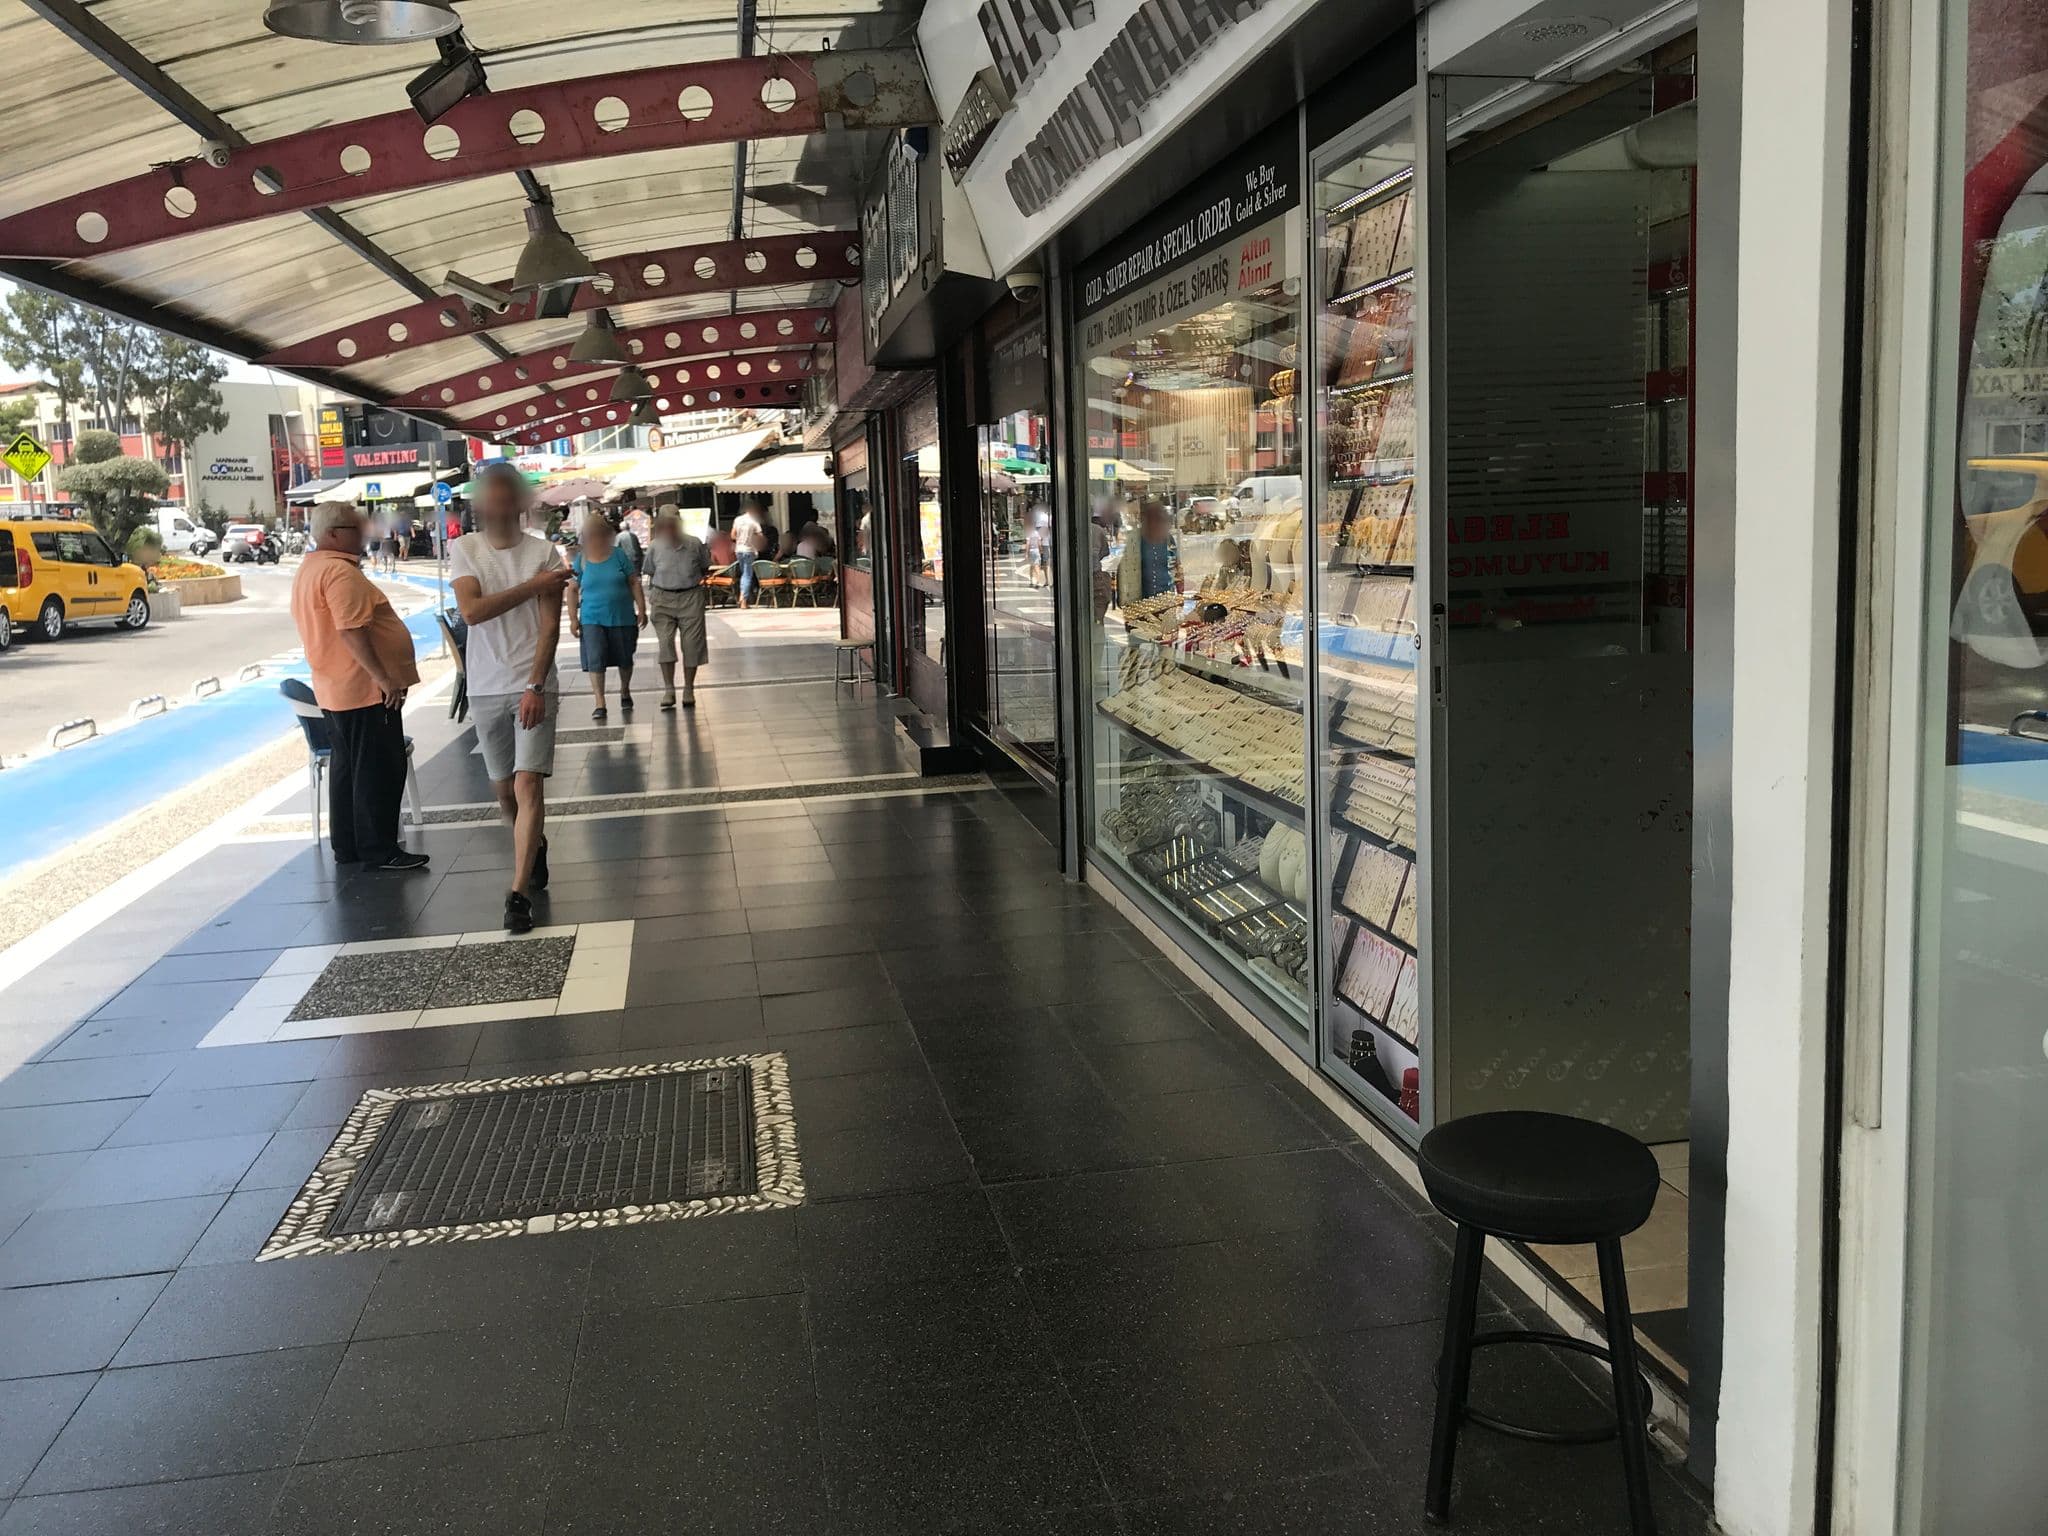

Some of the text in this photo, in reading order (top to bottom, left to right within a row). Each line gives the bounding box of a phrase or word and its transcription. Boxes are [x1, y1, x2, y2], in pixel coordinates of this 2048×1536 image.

[977, 0, 1095, 101] ELE
[1085, 0, 1263, 147] JEWELLE
[1245, 164, 1275, 193] We Buy
[1235, 183, 1287, 222] Gold & Silver
[1085, 276, 1103, 307] GOLD
[1105, 260, 1128, 296] SILVER
[1127, 244, 1154, 283] REPAIR
[1154, 239, 1162, 268] &
[1162, 218, 1197, 264] SPECIAL
[1198, 197, 1232, 244] ORDER
[1241, 236, 1271, 265] Altın
[1237, 260, 1273, 291] Alınır
[1086, 320, 1104, 350] ALTIN
[1108, 303, 1133, 338] GÜMÜŞ
[1133, 289, 1158, 328] TAMİR
[1158, 291, 1165, 318] &
[1166, 280, 1190, 314] ÖZEL
[1191, 254, 1230, 303] SİPARİŞ
[353, 449, 419, 467] VALENTINO
